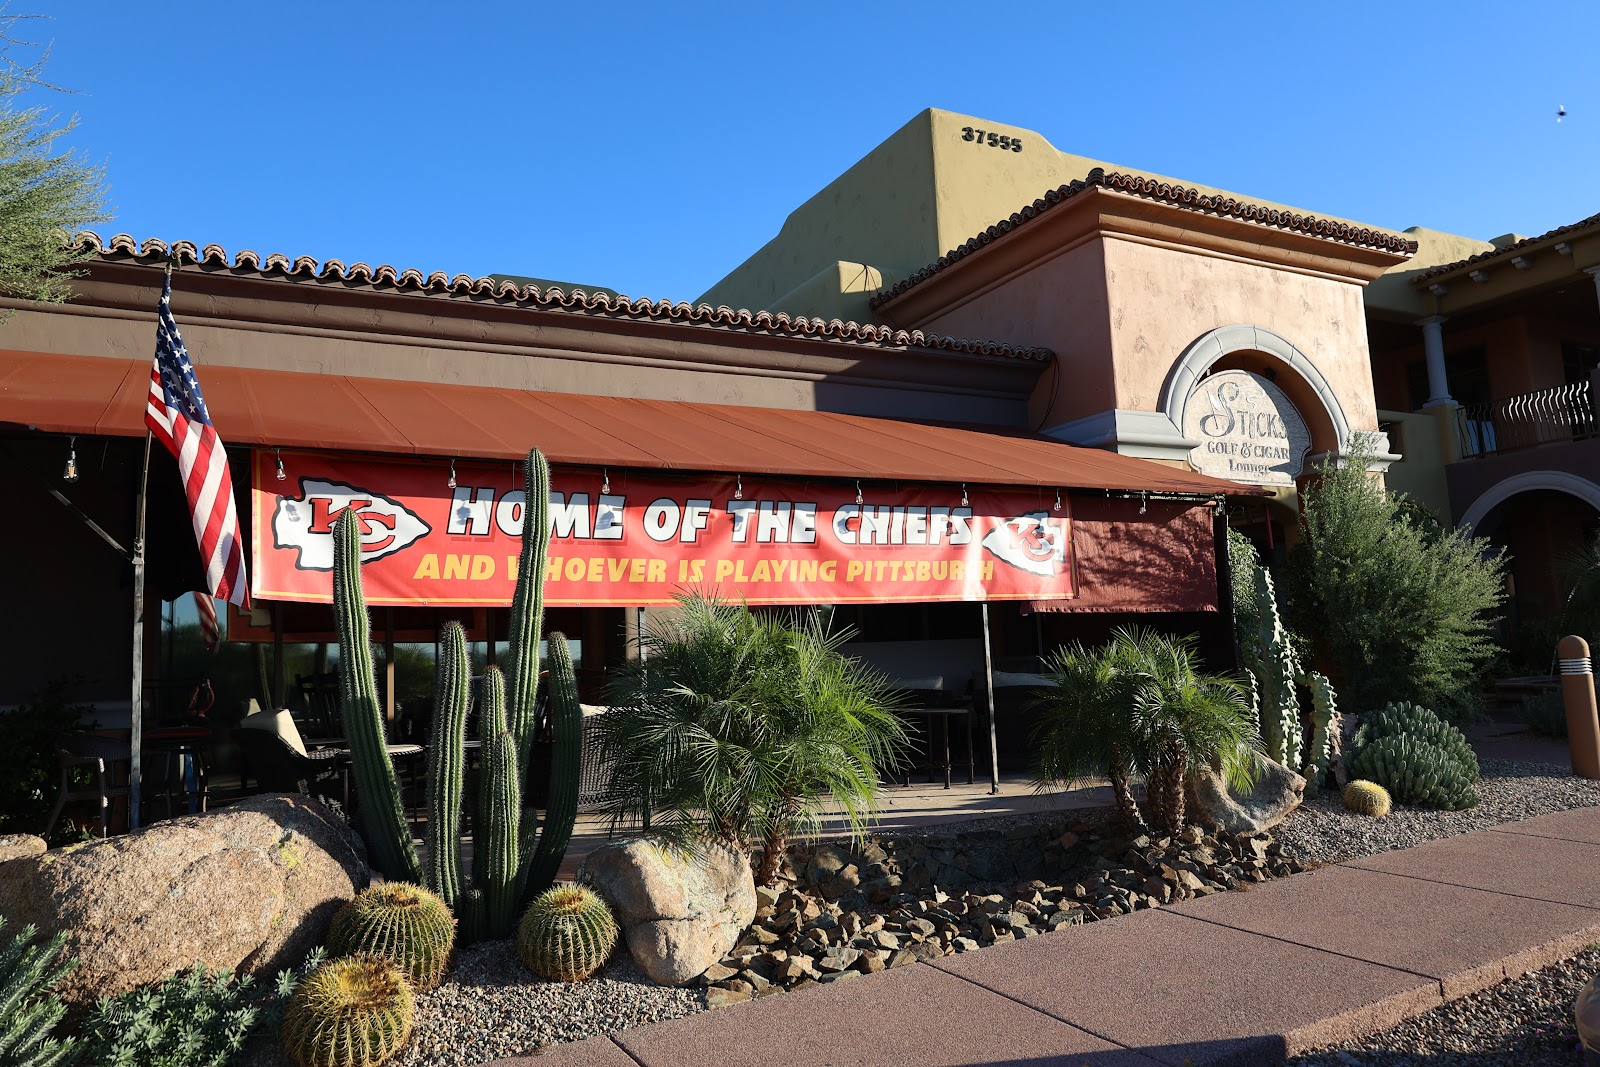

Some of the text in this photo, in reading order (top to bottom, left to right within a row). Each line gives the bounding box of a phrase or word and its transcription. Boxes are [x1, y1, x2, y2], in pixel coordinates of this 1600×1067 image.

[961, 126, 1023, 153] 37555
[1207, 440, 1289, 460] GOLF & CIGAR
[643, 497, 711, 543] OF
[724, 500, 817, 544] THE
[831, 503, 973, 546] CHIEFS
[412, 553, 496, 581] AND
[677, 559, 706, 583] IS
[715, 560, 837, 583] PLAYING
[845, 560, 994, 582] PITTSBURH
